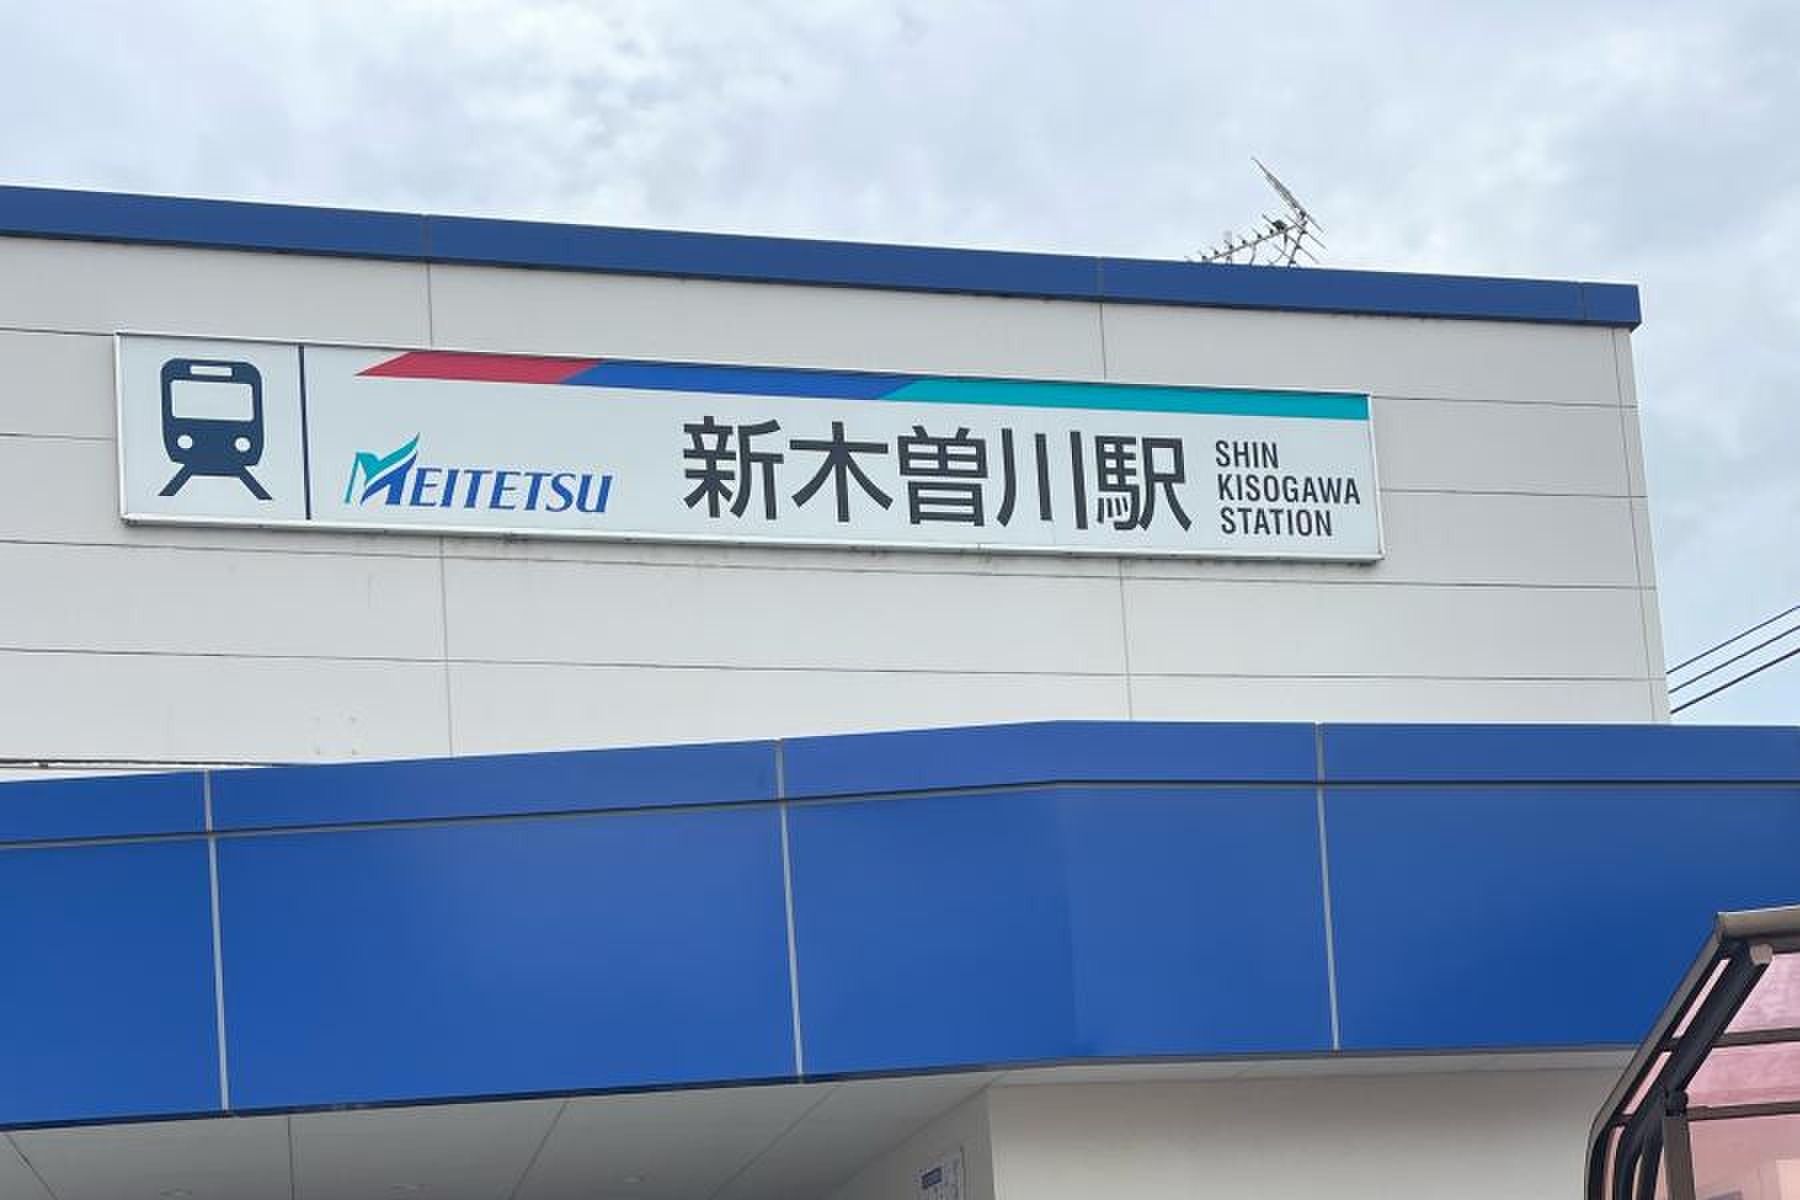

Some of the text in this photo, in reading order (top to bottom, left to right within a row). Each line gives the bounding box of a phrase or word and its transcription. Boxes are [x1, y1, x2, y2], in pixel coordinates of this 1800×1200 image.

[1216, 440, 1279, 469] SHIN
[344, 431, 613, 513] MEITETSU
[683, 416, 1192, 531] 新木曽川駅
[1217, 473, 1361, 505] KISOGAWA
[1220, 506, 1333, 536] STATION
